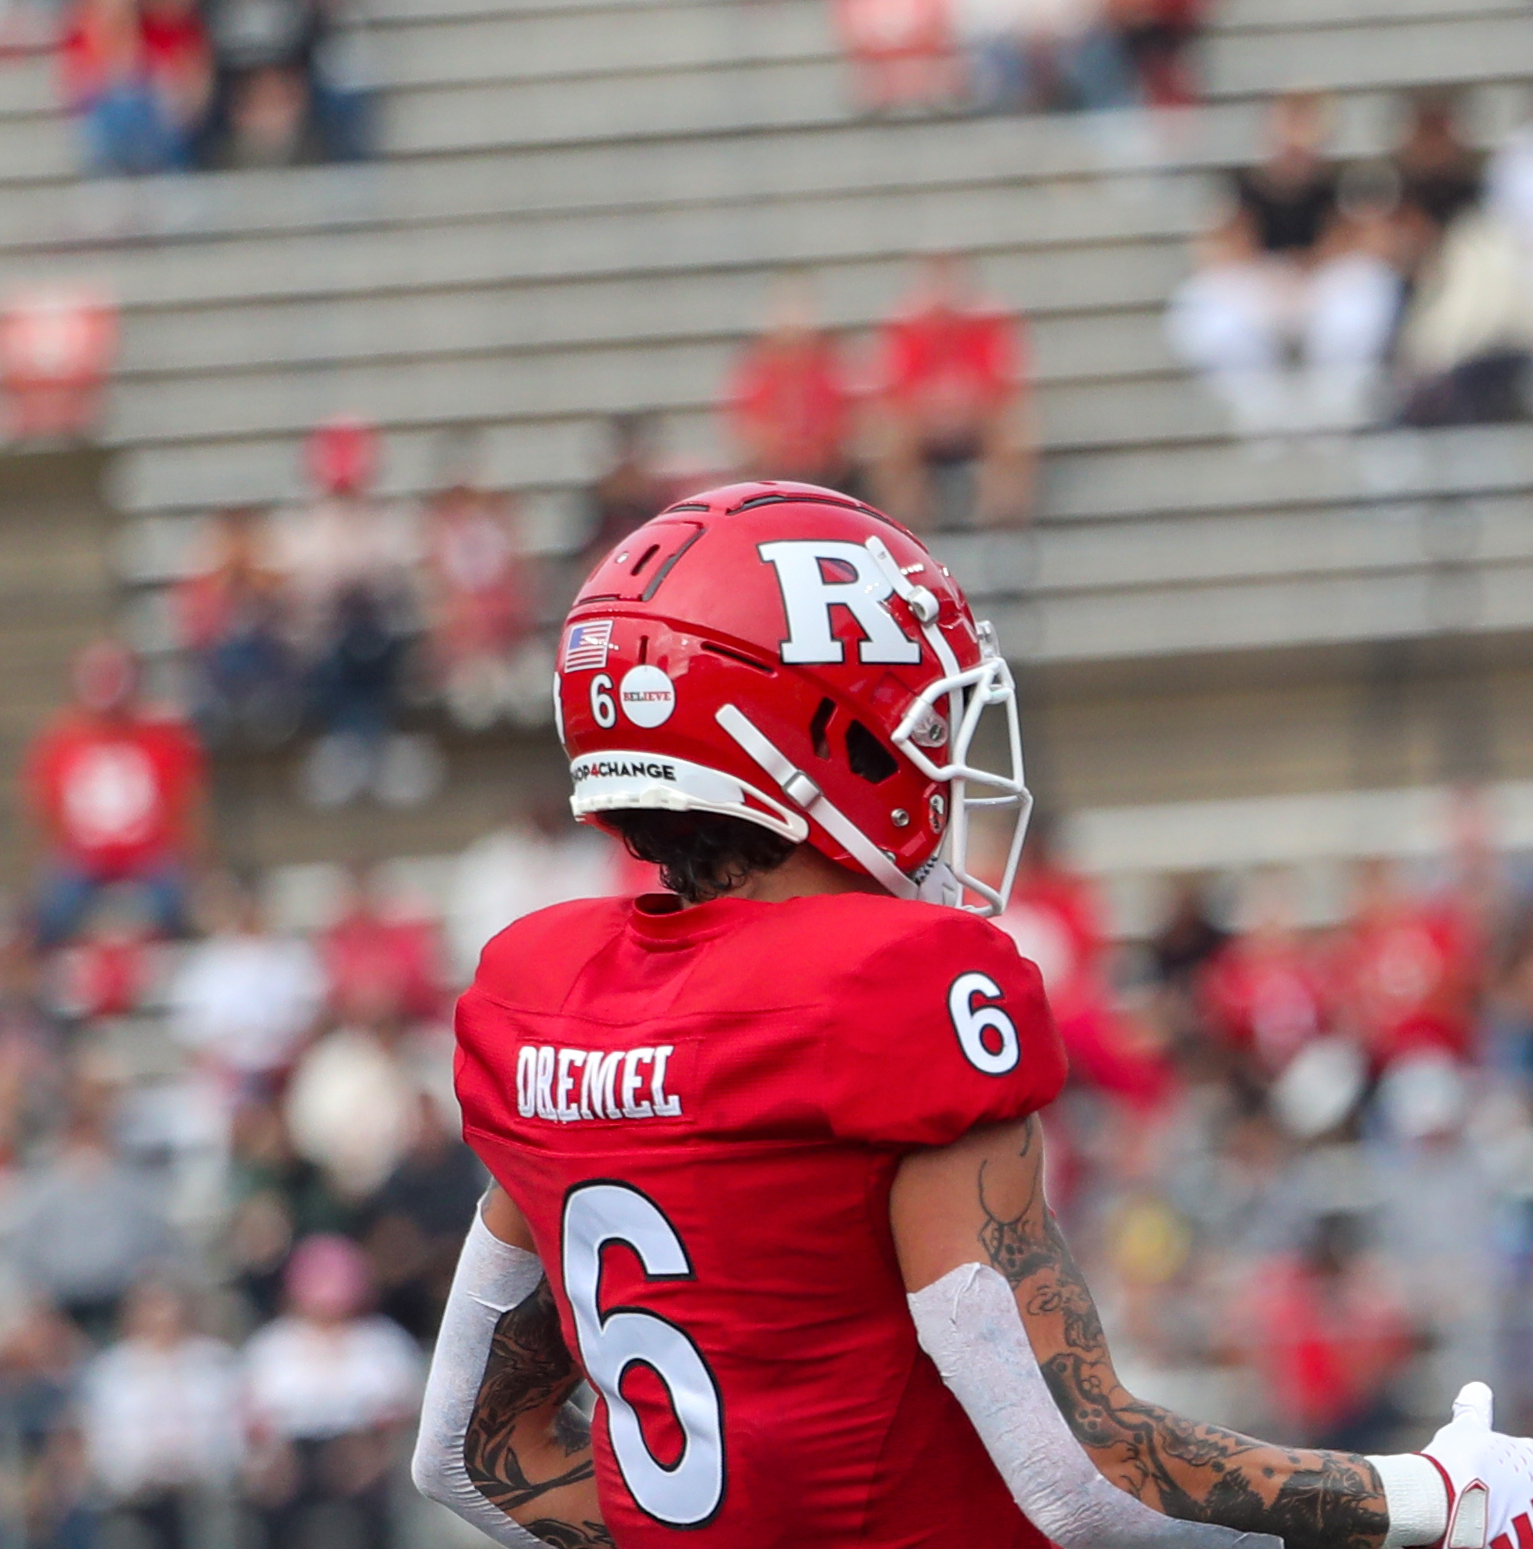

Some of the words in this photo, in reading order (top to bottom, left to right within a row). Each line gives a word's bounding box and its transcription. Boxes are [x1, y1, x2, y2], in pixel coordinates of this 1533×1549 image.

[757, 539, 922, 666] R
[590, 673, 618, 729] 6
[623, 691, 672, 702] BELIEVE
[573, 762, 678, 782] OP4CHANGE
[947, 971, 1021, 1078] 6
[516, 1045, 683, 1122] DREMEL
[560, 1178, 727, 1530] 6
